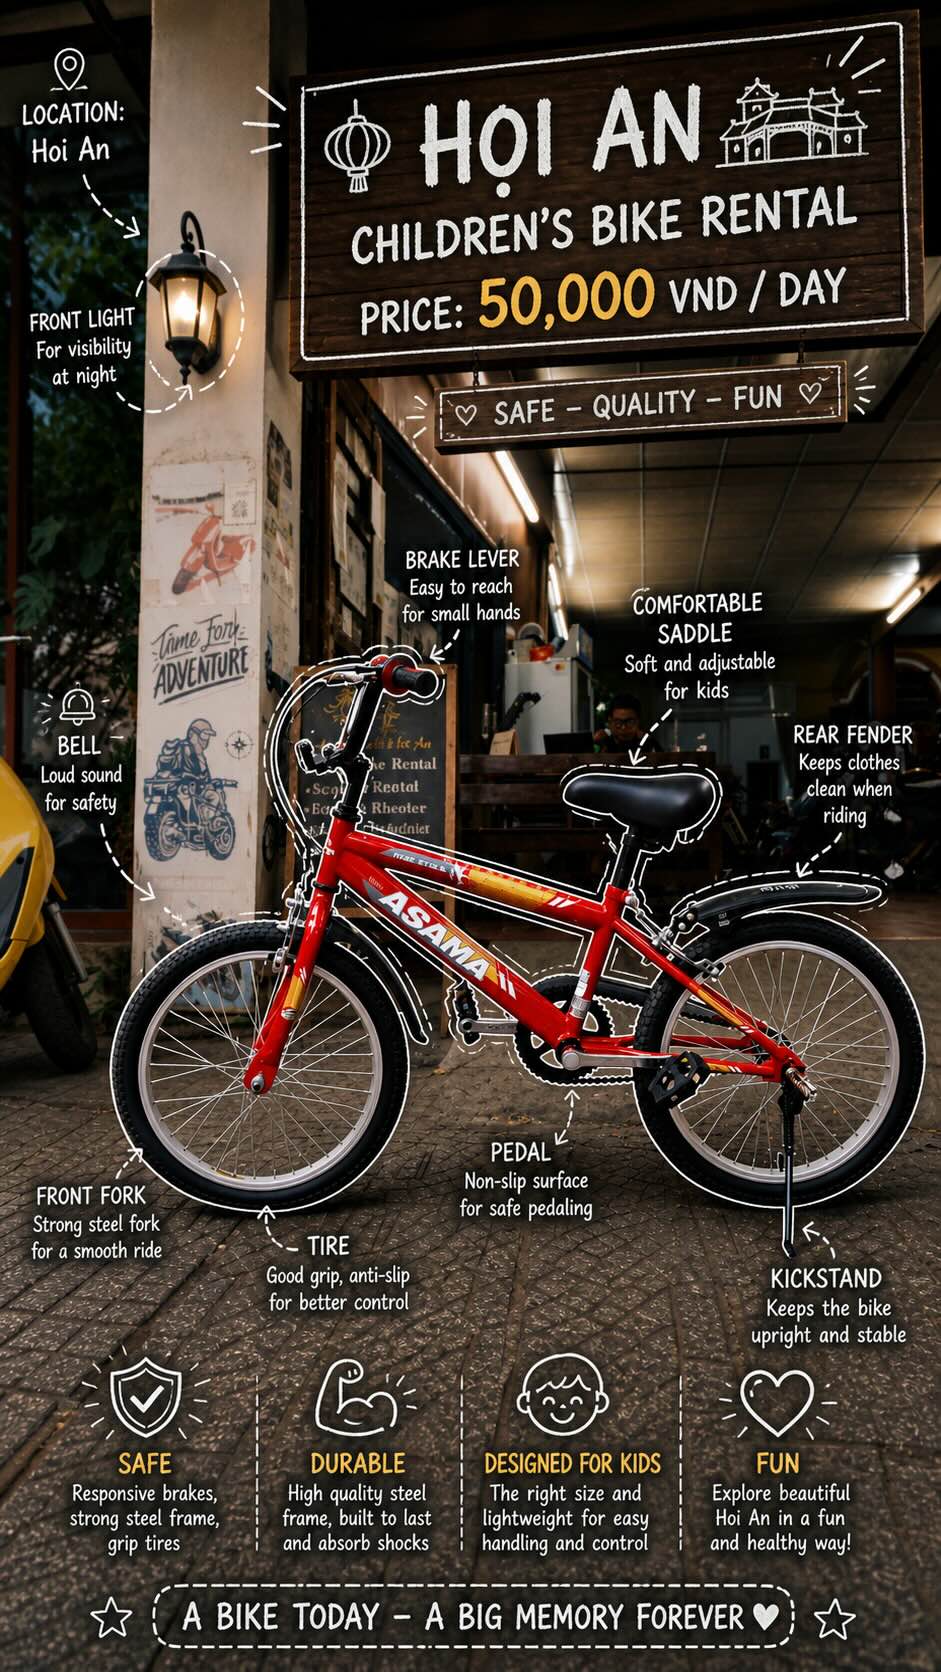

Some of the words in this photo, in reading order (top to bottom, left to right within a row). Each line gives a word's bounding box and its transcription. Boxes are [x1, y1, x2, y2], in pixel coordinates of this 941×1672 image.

[592, 83, 701, 172] AN
[352, 207, 573, 264] CHILDREN'S
[592, 199, 682, 246] BIKE
[701, 185, 857, 237] RENTAL
[361, 296, 463, 335] PRICE:
[479, 268, 655, 330] 50,000
[669, 276, 737, 313] VND
[749, 269, 766, 312] /
[780, 267, 846, 307] DAY
[494, 398, 555, 426] SAFE
[593, 389, 696, 420] QUALITY
[734, 384, 782, 410] FUN
[153, 646, 249, 699] ADVENTURE
[391, 757, 437, 770] Rental
[378, 890, 491, 982] ASAMA
